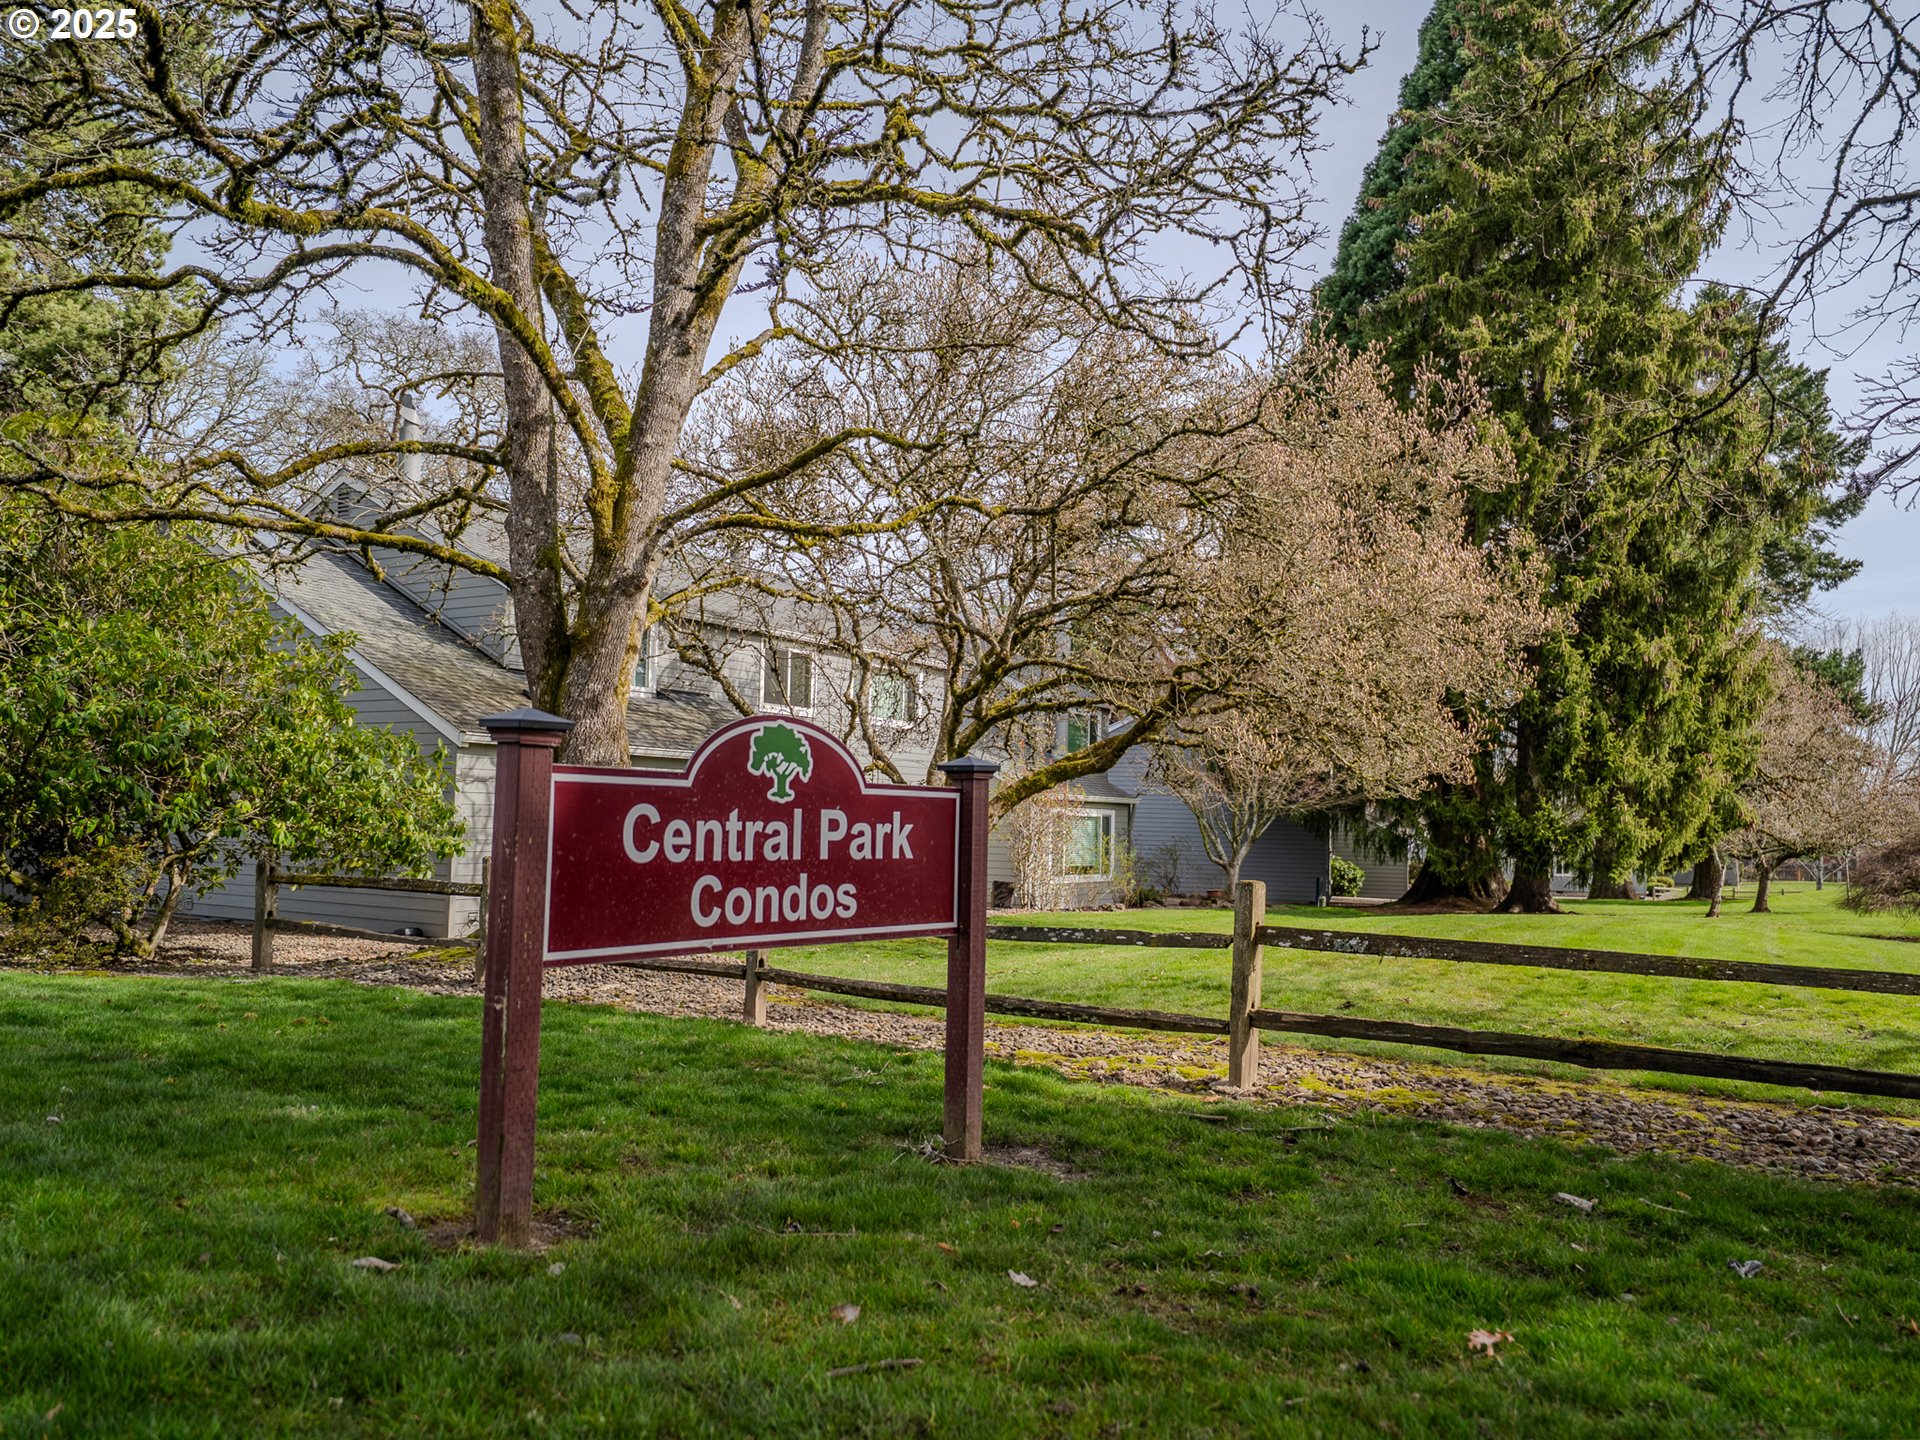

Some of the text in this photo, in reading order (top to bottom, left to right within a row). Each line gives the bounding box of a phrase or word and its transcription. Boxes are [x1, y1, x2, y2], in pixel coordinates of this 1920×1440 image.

[622, 803, 914, 864] Central Park
[690, 873, 858, 928] Condos
